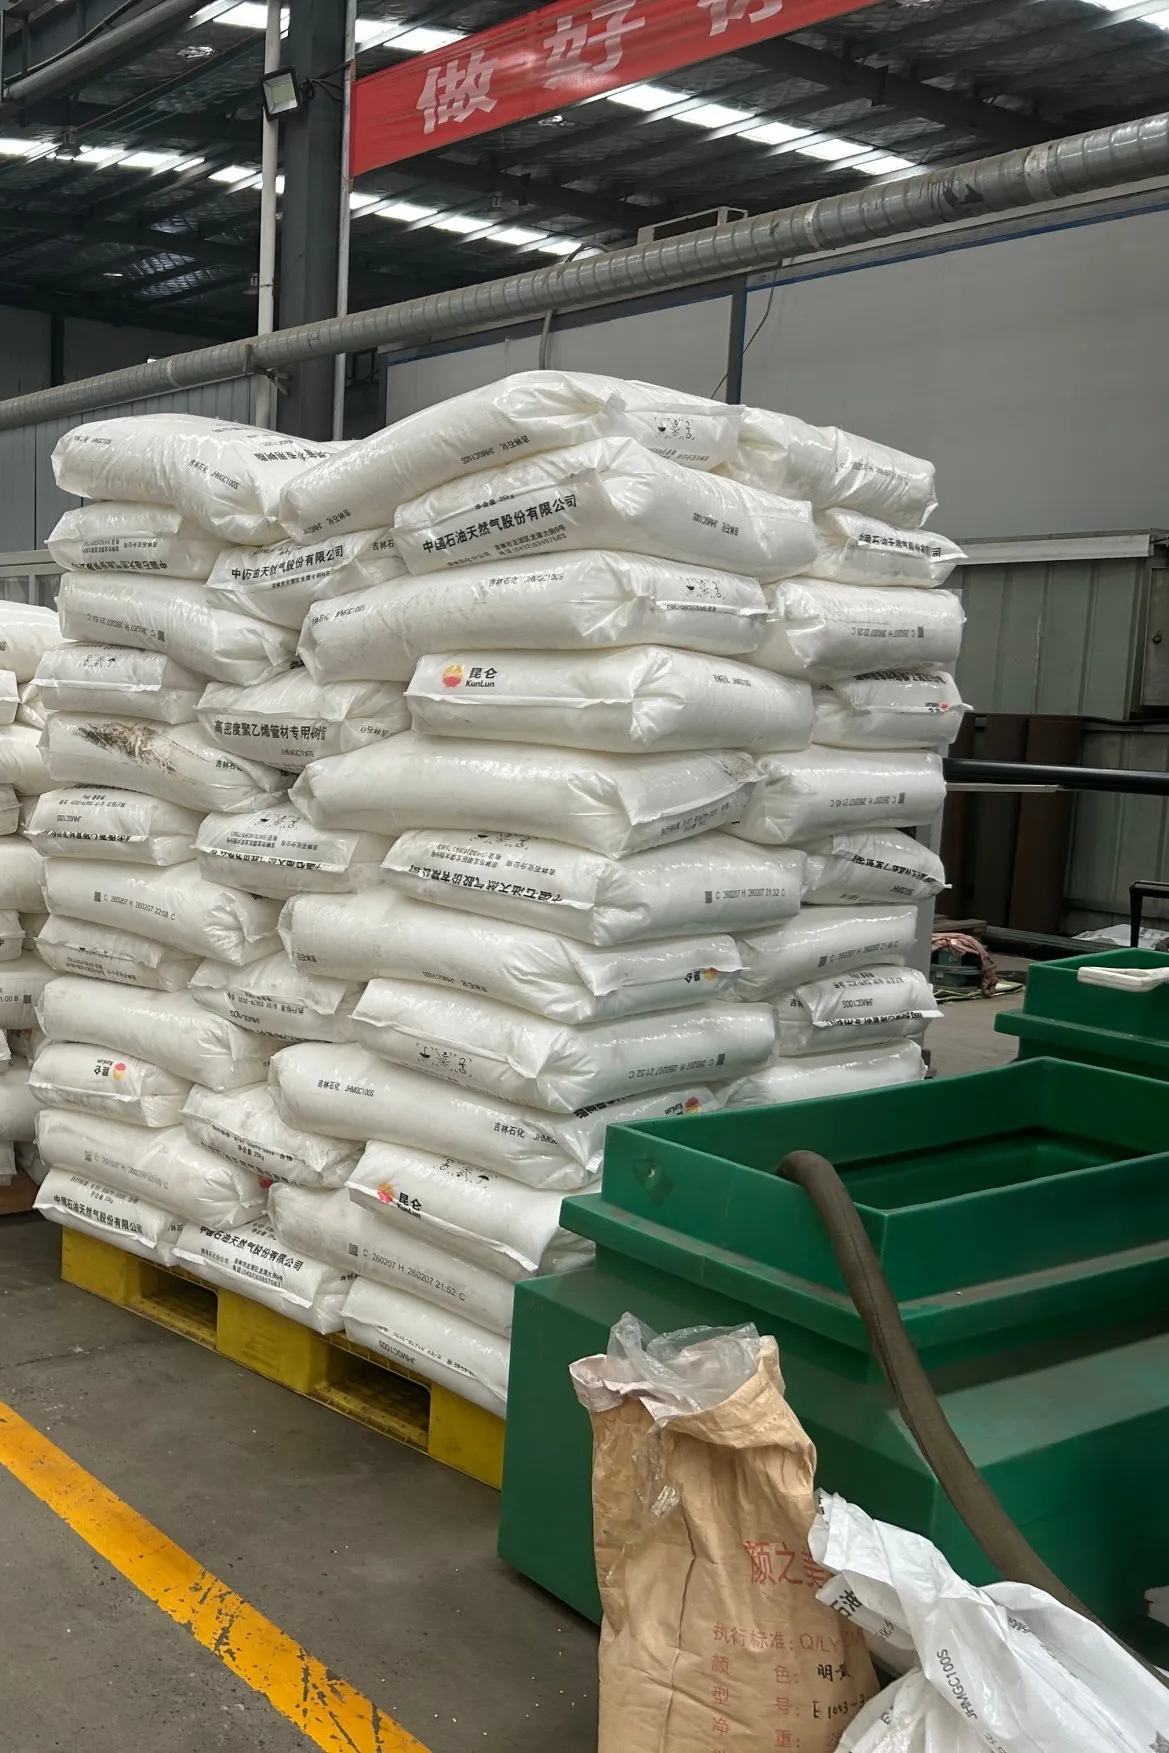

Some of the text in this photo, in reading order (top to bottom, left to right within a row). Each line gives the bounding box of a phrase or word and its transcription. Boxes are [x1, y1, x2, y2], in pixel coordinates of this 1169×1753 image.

[500, 434, 531, 451] 吉林石化
[422, 493, 578, 555] 中国石油天然气股份有限公司
[231, 545, 345, 581] 中石油天然气股份有限公司
[465, 679, 495, 688] KunLun
[468, 667, 498, 679] 昆仑
[214, 719, 328, 742] 高密度聚乙烯管材专用树脂
[93, 1065, 111, 1077] 昆仑
[317, 1078, 341, 1091] 吉林石化
[493, 1121, 526, 1140] 吉林石化
[398, 1191, 423, 1212] 昆仑
[199, 1225, 305, 1273] 中国石油天然气股份有限公司
[362, 1248, 467, 1302] C 260207 H 260207 21:52 C
[936, 1648, 978, 1721] JHMGC100S
